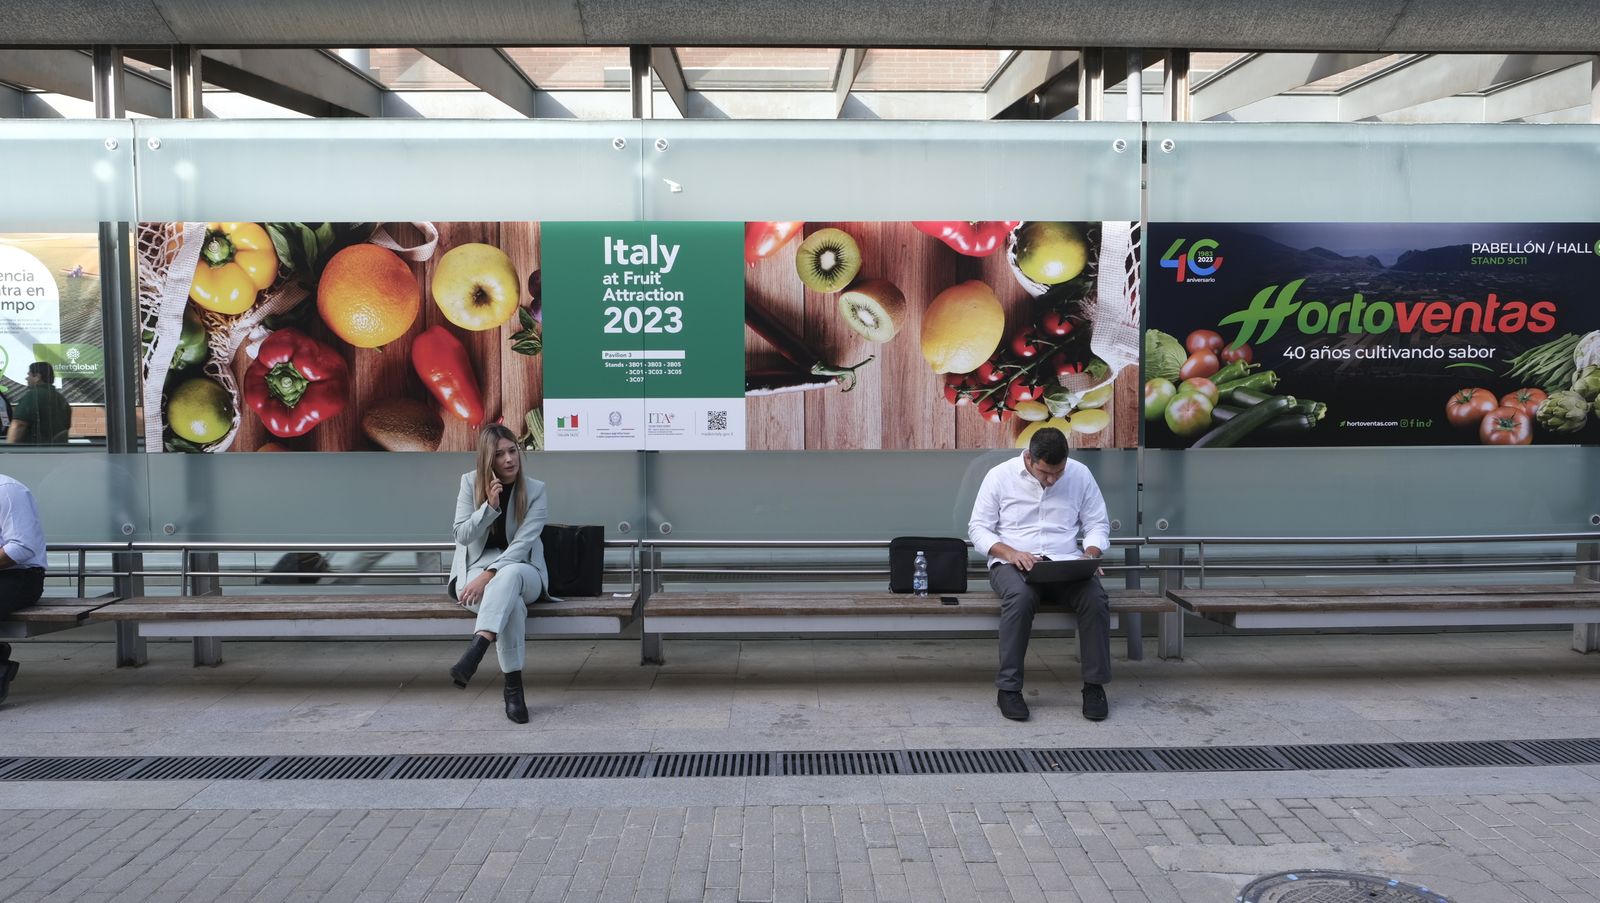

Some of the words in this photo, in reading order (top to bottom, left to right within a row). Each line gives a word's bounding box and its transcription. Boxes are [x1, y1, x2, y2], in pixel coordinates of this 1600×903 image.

[604, 234, 680, 274] Italy
[1471, 240, 1545, 254] PABELLÓN
[1557, 242, 1592, 254] HALL
[1471, 257, 1505, 265] STAND
[1508, 257, 1527, 265] 9C11
[602, 272, 619, 285] at
[623, 271, 661, 285] Fruit
[0, 284, 21, 297] tra
[26, 287, 45, 297] en
[602, 287, 684, 301] Attraction
[603, 306, 683, 334] 2023
[1218, 278, 1557, 350] Hortoventas
[1283, 347, 1306, 360] 40
[1310, 346, 1351, 360] años
[1355, 345, 1445, 360] cultivando
[1448, 345, 1496, 359] sabor
